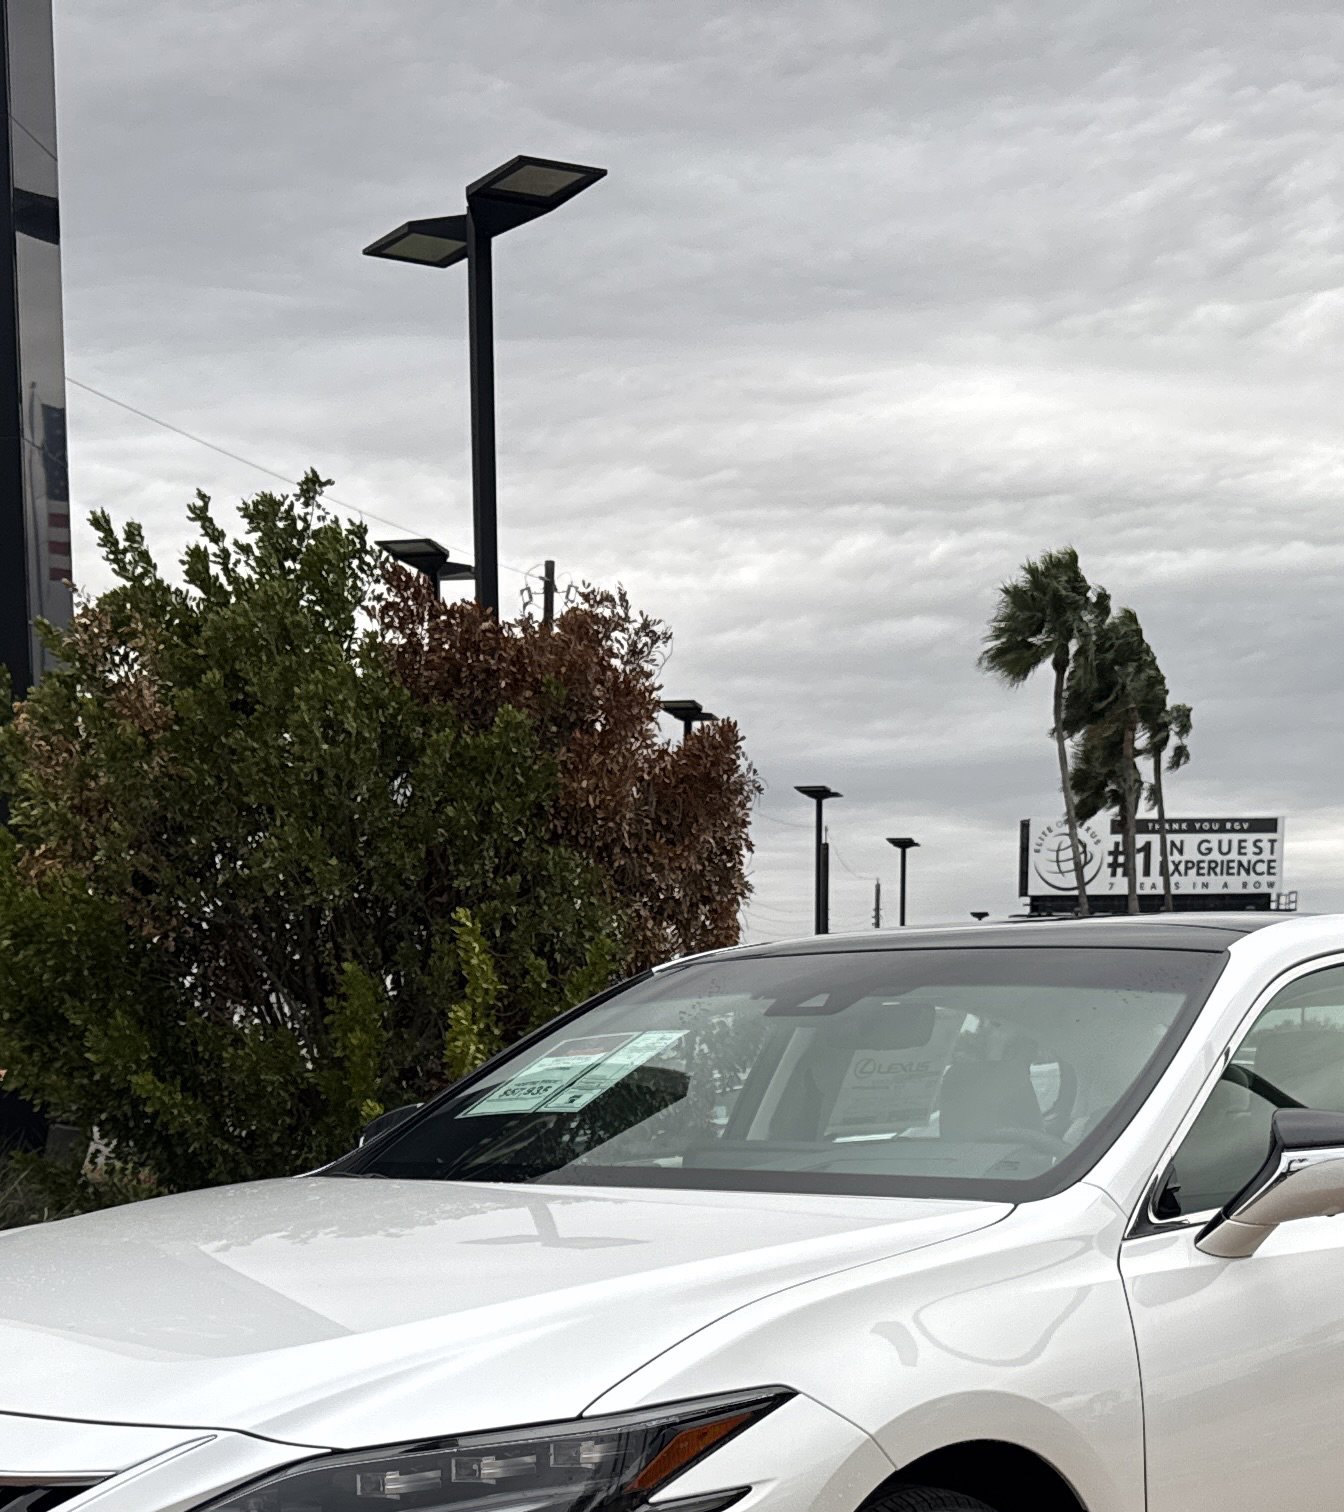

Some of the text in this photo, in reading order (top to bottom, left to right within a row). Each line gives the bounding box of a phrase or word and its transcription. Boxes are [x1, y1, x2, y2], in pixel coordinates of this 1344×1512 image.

[1194, 822, 1219, 830] YOU
[1225, 822, 1249, 830] RGV
[1033, 826, 1053, 853] ELITE
[1107, 840, 1151, 878] #1
[1196, 838, 1278, 856] GUEST
[1108, 882, 1114, 891] 7
[1192, 881, 1209, 890] IN
[1221, 881, 1229, 890] A
[1241, 880, 1275, 890] ROW
